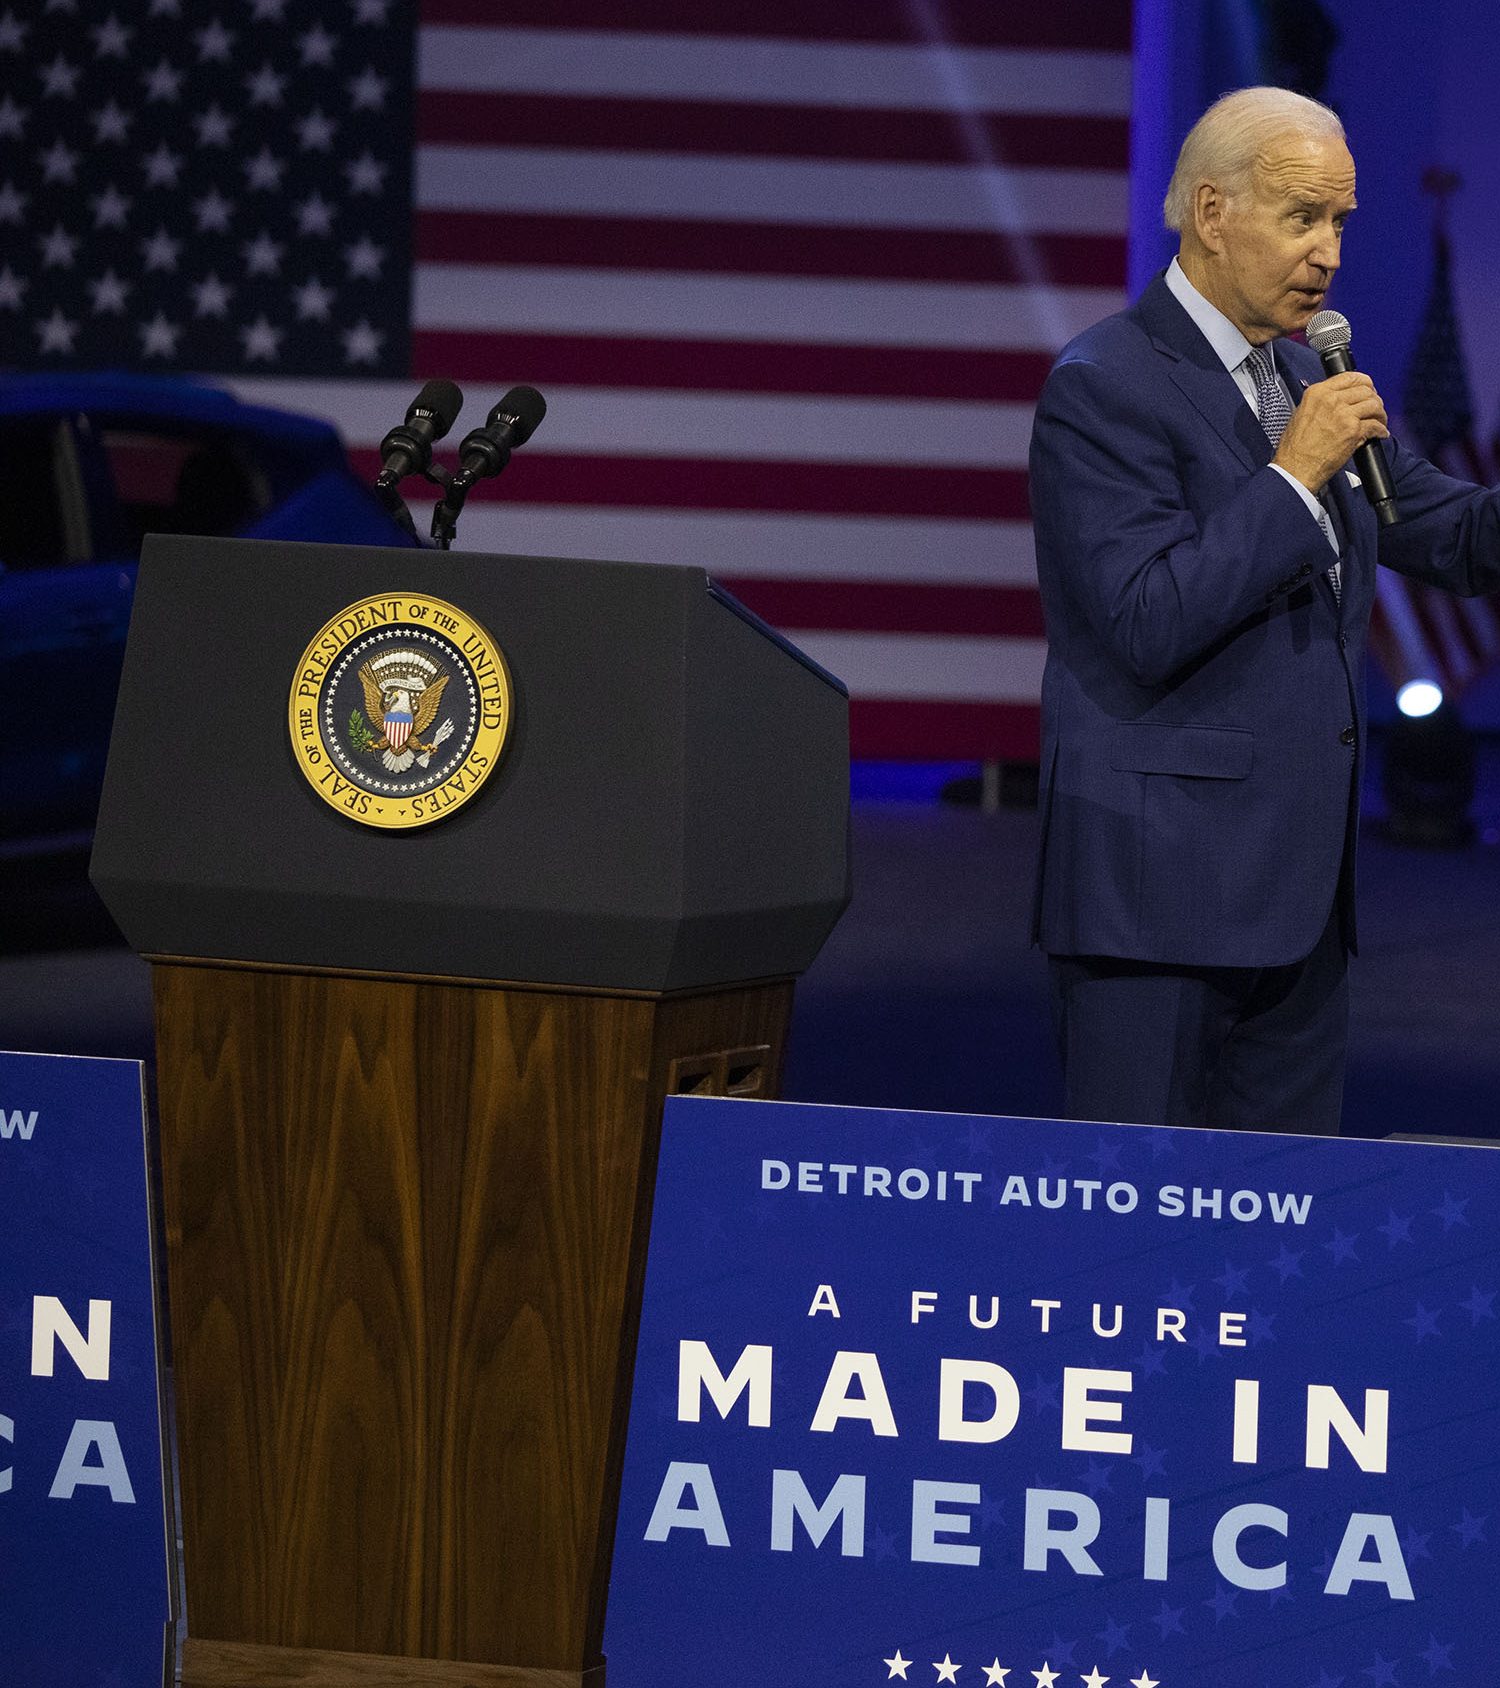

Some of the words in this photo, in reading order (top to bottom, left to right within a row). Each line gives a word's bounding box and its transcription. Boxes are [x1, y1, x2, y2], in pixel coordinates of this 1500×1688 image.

[408, 604, 430, 620] OF
[432, 610, 461, 635] THE
[298, 601, 403, 700] PRESIDENT
[462, 632, 502, 730] UNITED
[299, 708, 315, 741] THE
[304, 743, 322, 765] OF
[319, 763, 373, 815] SEAL
[411, 750, 489, 819] STATES
[761, 1158, 983, 1203] DETROIT
[999, 1175, 1139, 1214] AUTO
[1158, 1185, 1313, 1225] SHOW
[807, 1284, 841, 1319] A
[911, 1290, 1248, 1347] FUTURE
[677, 1339, 1133, 1455] MADE
[1232, 1379, 1389, 1474] IN
[0, 1412, 137, 1504] A
[643, 1461, 1416, 1601] AMERICA
